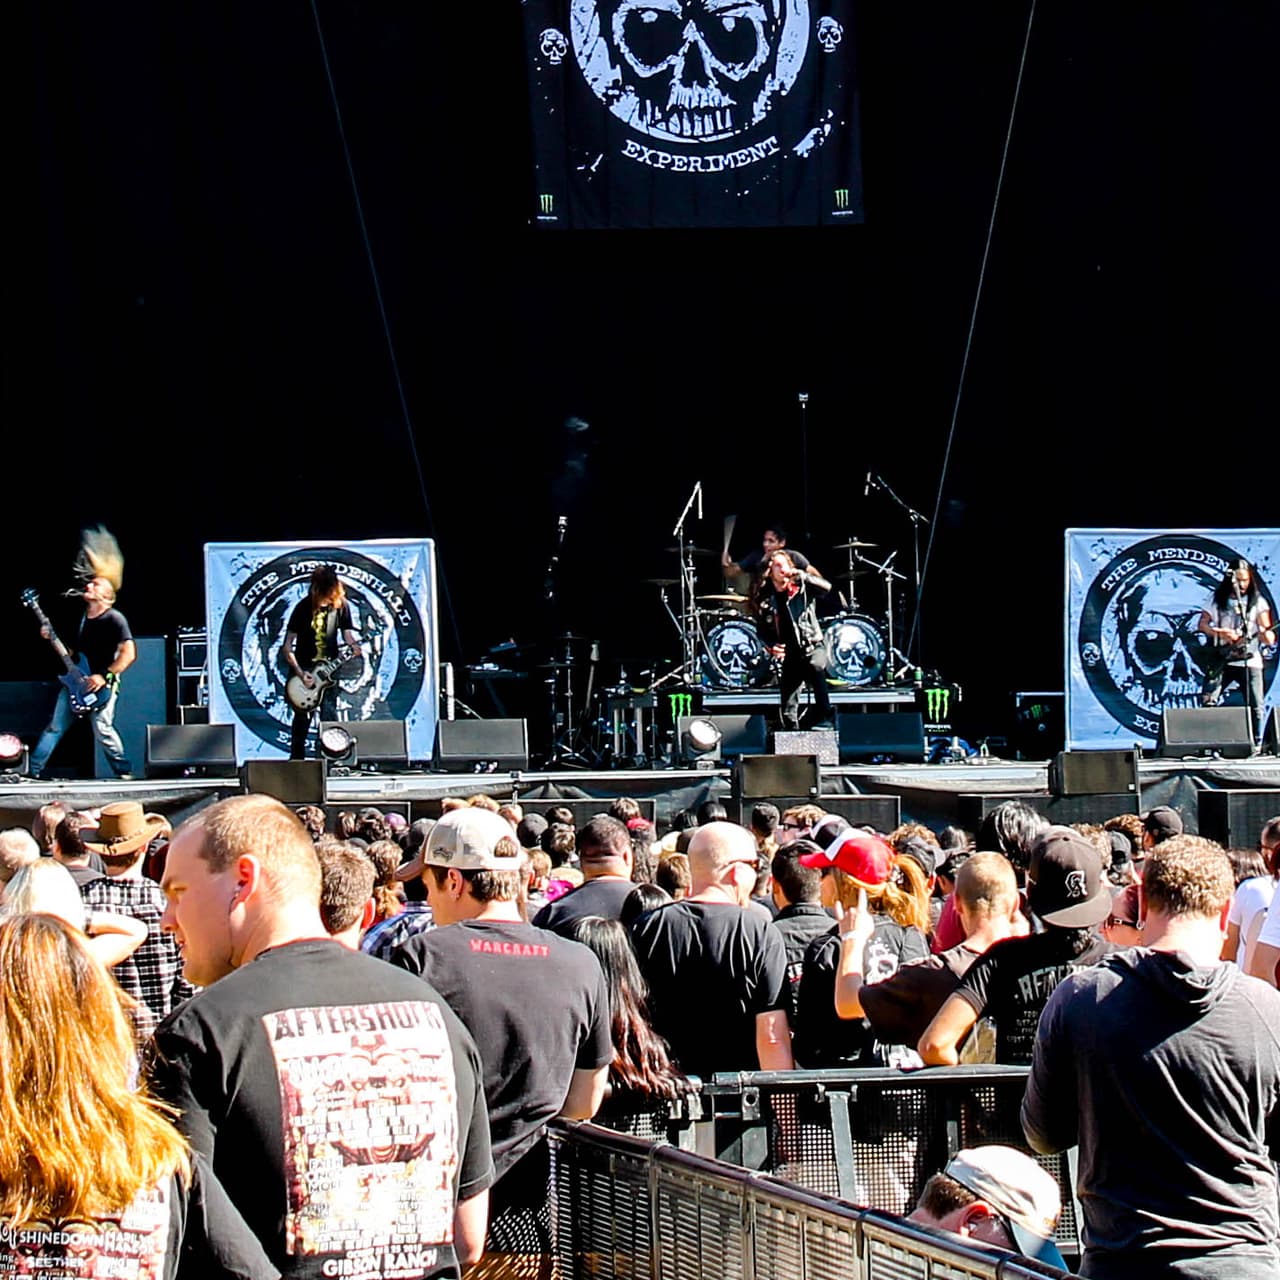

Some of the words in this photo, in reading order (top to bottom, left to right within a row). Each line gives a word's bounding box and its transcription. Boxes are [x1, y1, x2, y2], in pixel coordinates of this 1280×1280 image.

[620, 136, 781, 173] EXPERIMENT
[240, 571, 280, 607] THE
[1101, 558, 1138, 592] THE
[470, 938, 550, 957] WARCRAFT
[19, 1230, 104, 1247] SHINEDOWN
[27, 1256, 86, 1269] SEETHER
[322, 1256, 381, 1277] GIBSON
[383, 1248, 438, 1270] RANCH
